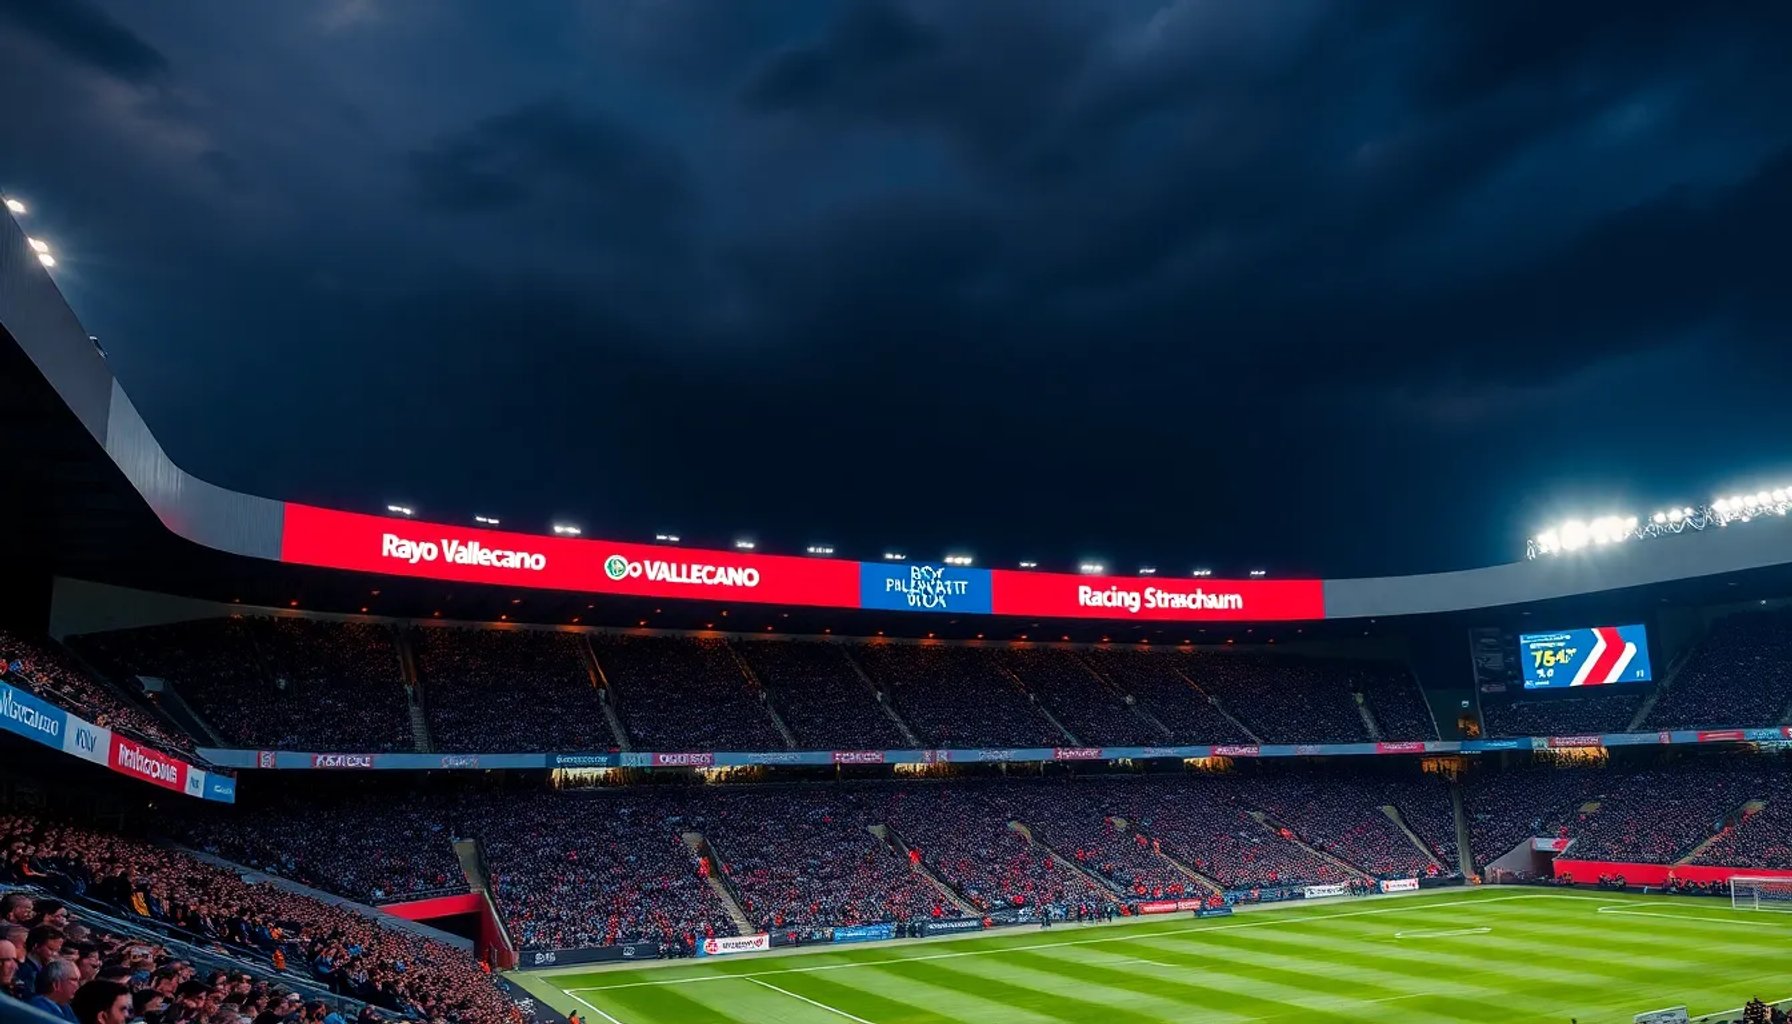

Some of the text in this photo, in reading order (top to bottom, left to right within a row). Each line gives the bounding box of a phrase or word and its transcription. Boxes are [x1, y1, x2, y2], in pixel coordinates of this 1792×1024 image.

[382, 533, 547, 571] Rayo Vallecano
[643, 559, 760, 587] VALLECANO
[1078, 585, 1141, 613] Racing
